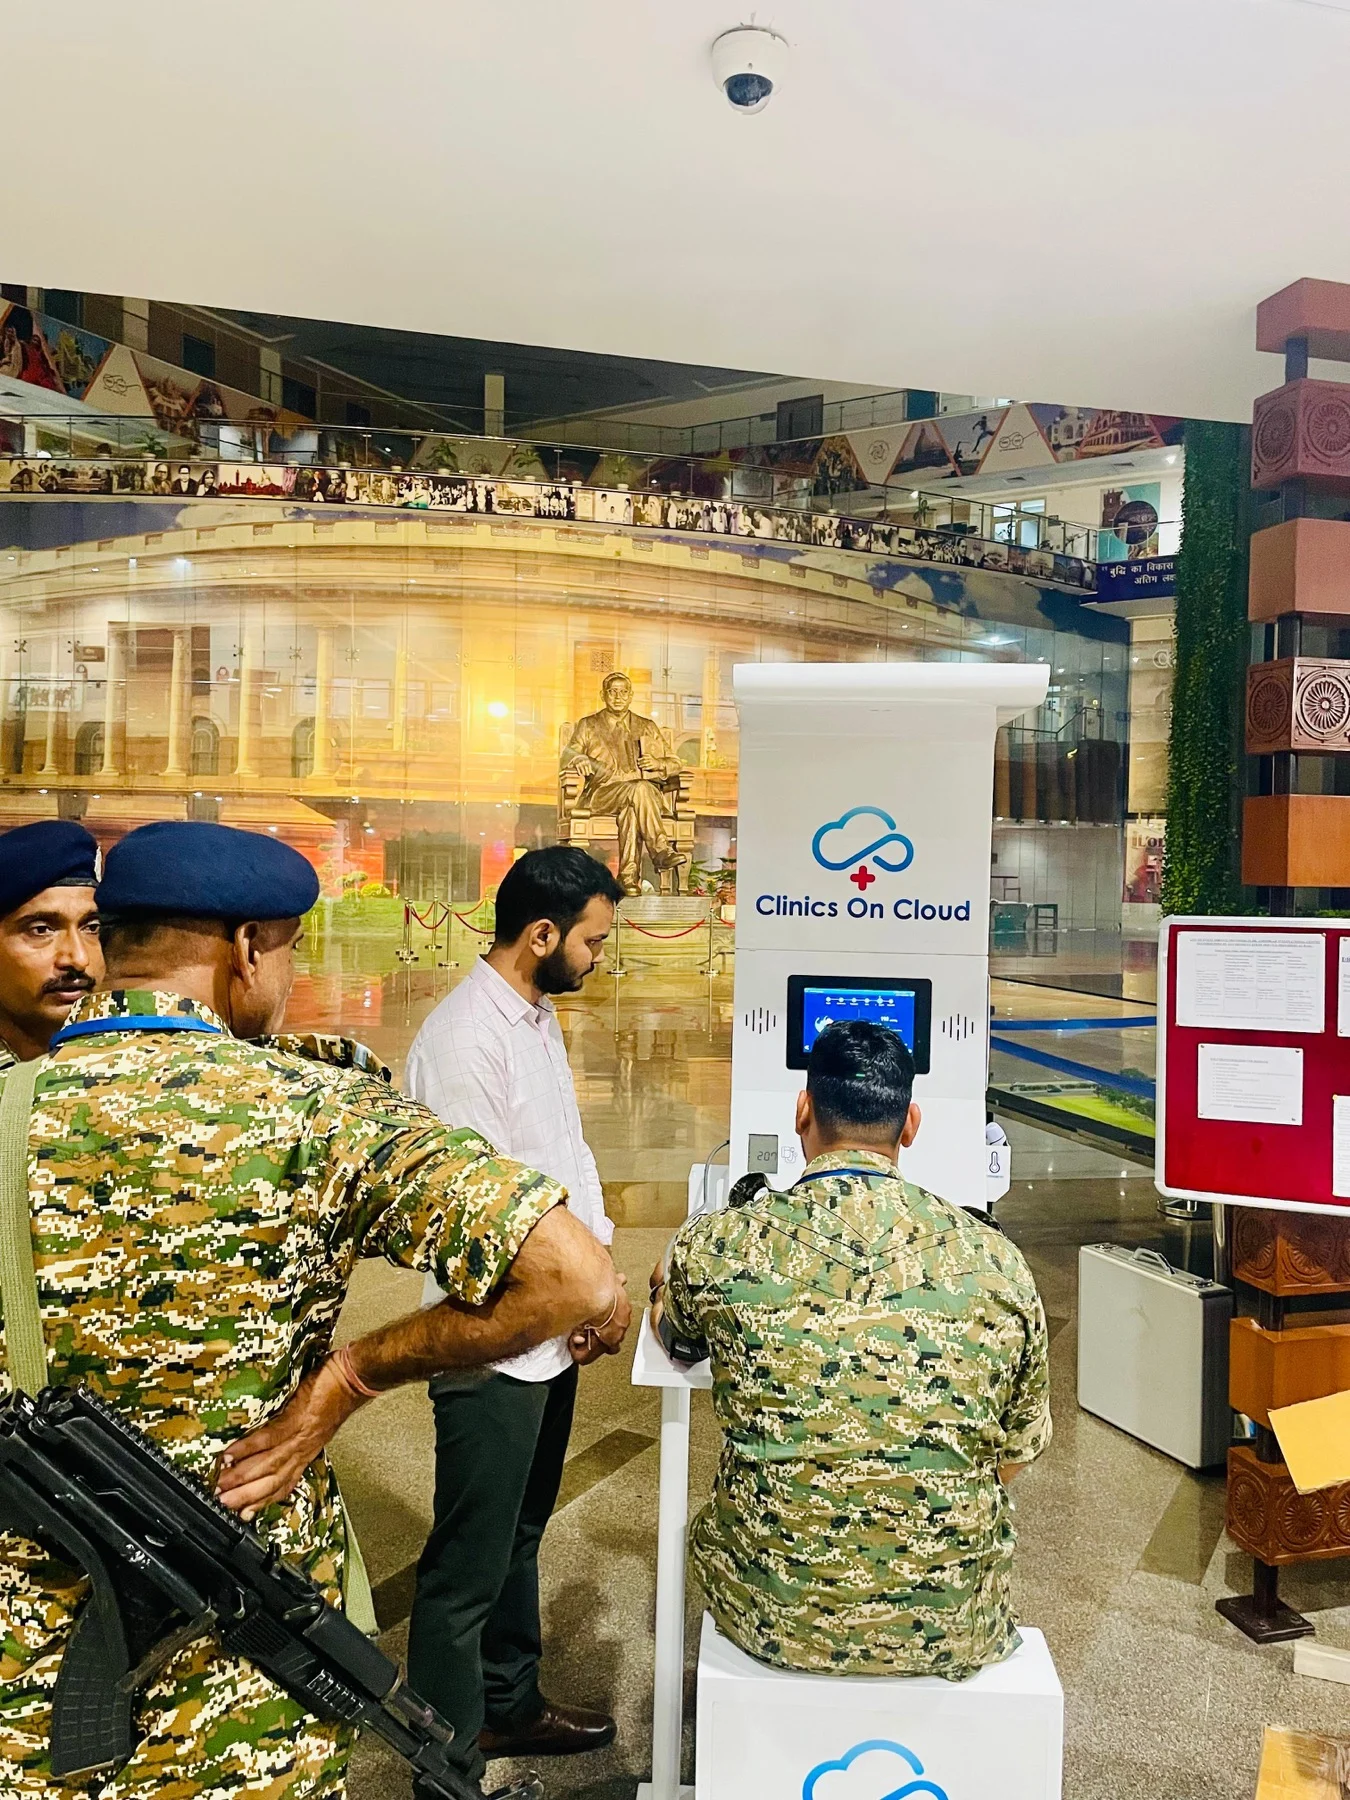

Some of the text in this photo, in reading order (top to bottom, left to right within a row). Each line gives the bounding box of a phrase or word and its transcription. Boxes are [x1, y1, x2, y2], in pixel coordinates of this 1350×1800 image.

[1131, 565, 1142, 573] का
[1146, 562, 1173, 572] विकास
[1134, 574, 1157, 585] अंतिम
[755, 894, 970, 921] Clinics On Cloud
